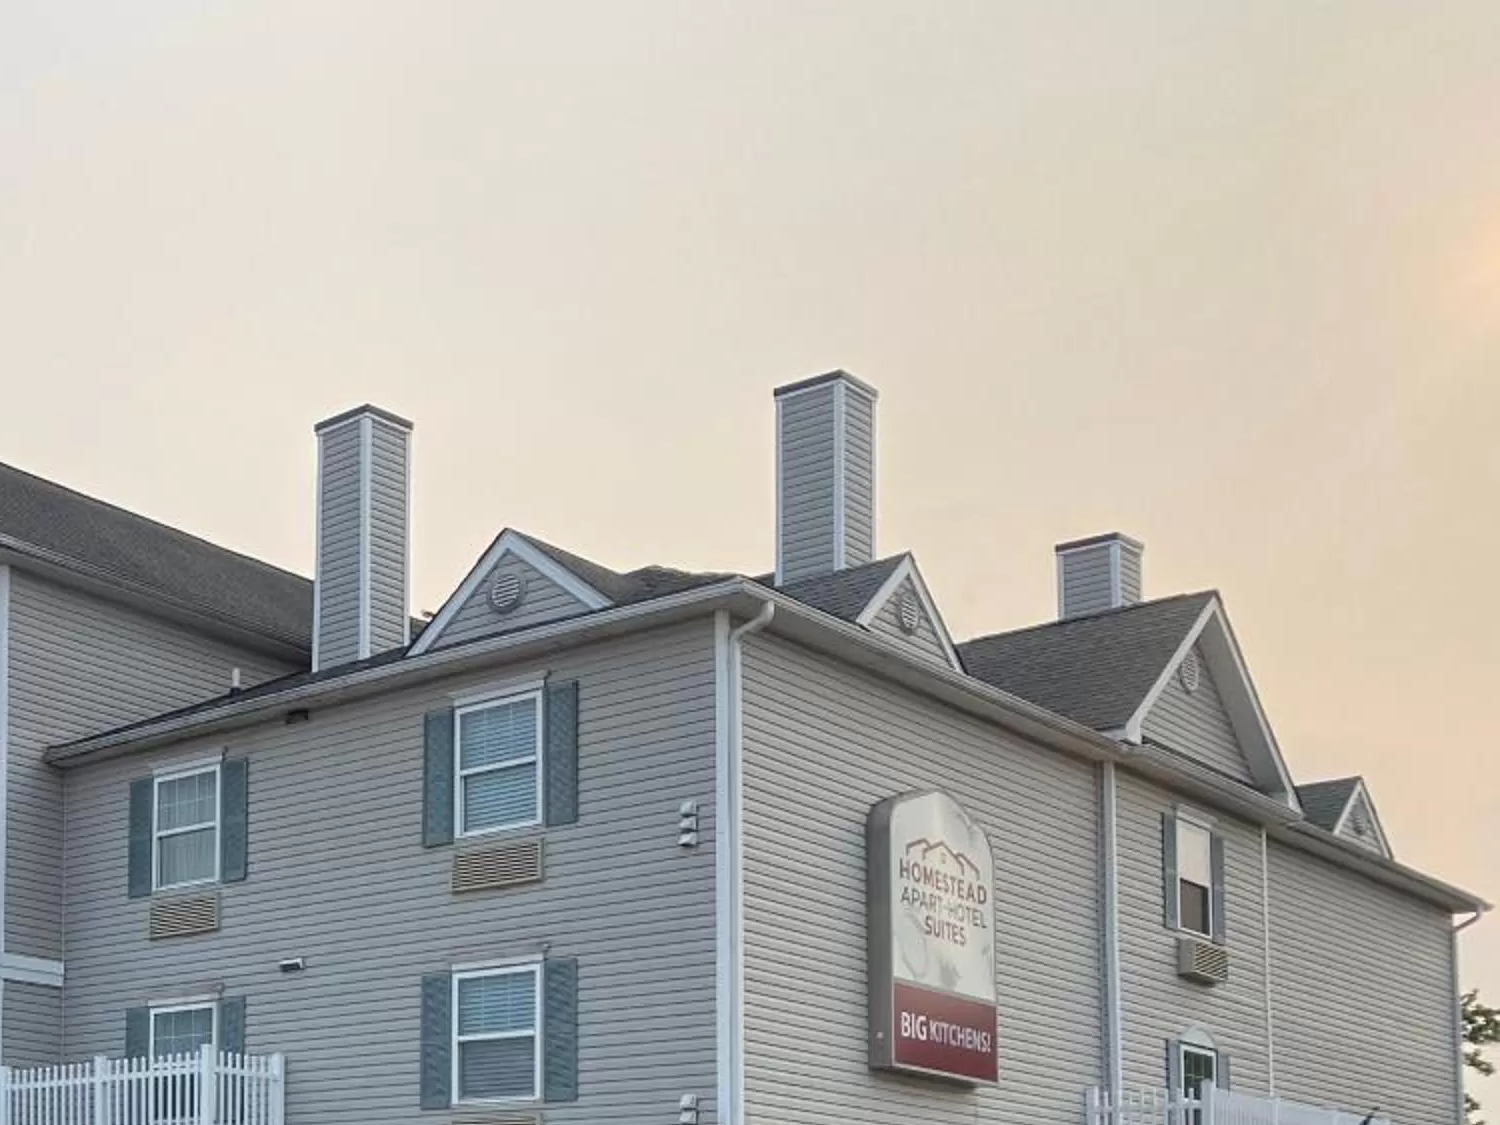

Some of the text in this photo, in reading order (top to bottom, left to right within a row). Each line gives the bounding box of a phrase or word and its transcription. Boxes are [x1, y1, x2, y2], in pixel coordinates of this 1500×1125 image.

[899, 857, 988, 905] HOMESTEAD
[924, 915, 966, 947] SUITES
[900, 1011, 992, 1054] BIG KITCHENS!
